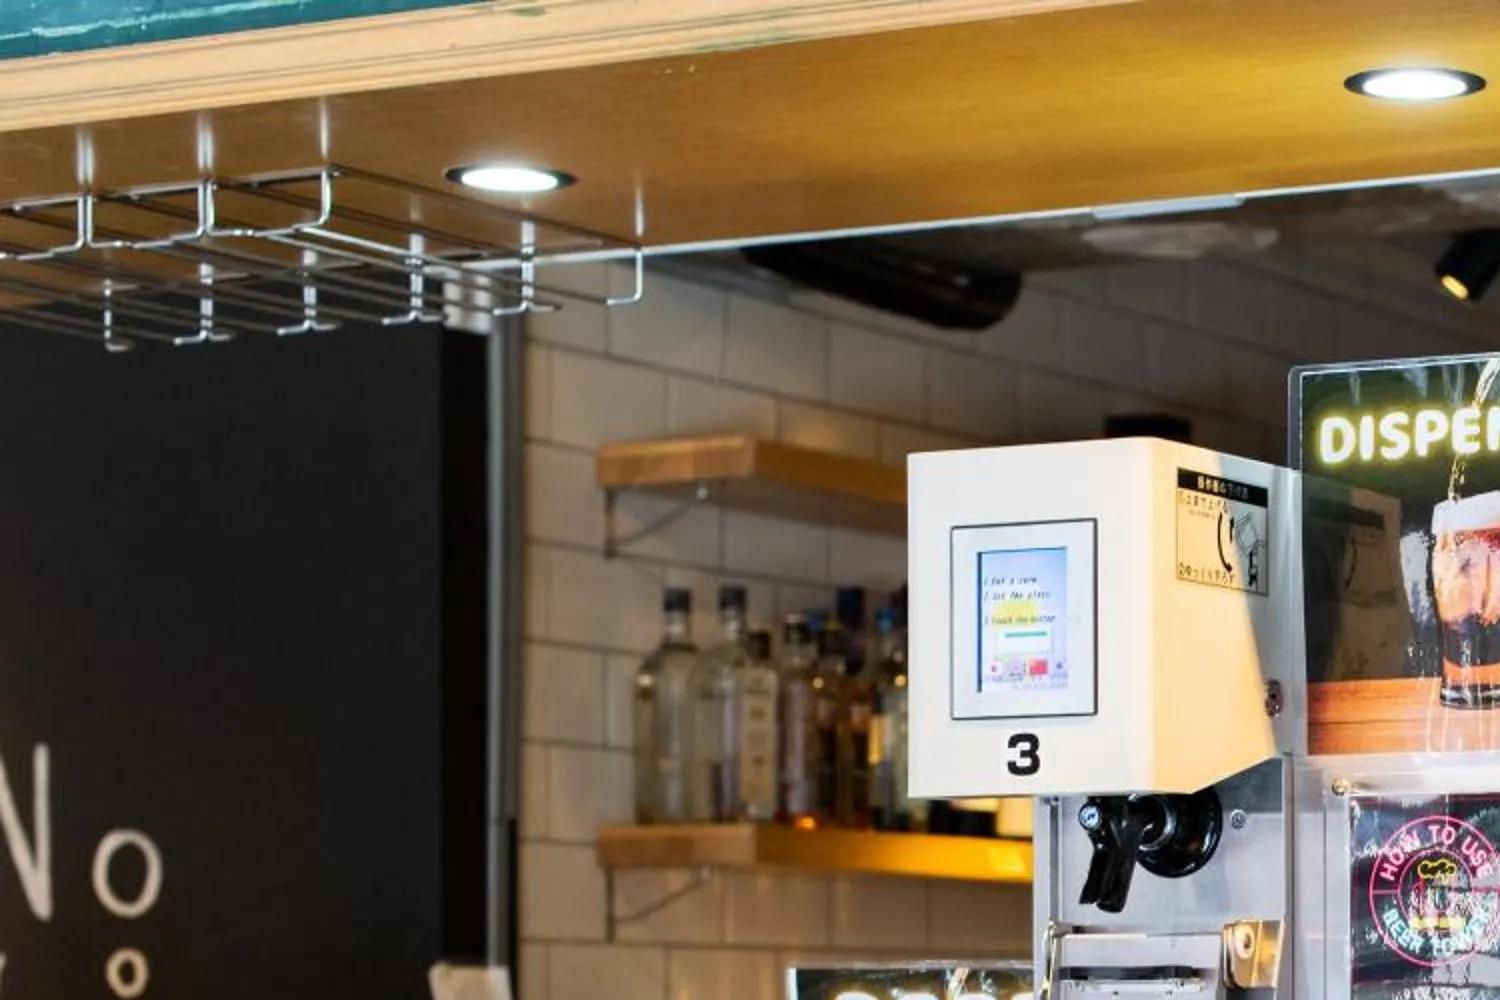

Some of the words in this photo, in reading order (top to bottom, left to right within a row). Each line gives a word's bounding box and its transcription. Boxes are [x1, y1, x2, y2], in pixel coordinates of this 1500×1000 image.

[1007, 732, 1041, 777] 3
[1379, 829, 1421, 881] HOW
[1428, 824, 1456, 846] TO
[1461, 835, 1494, 879] USE
